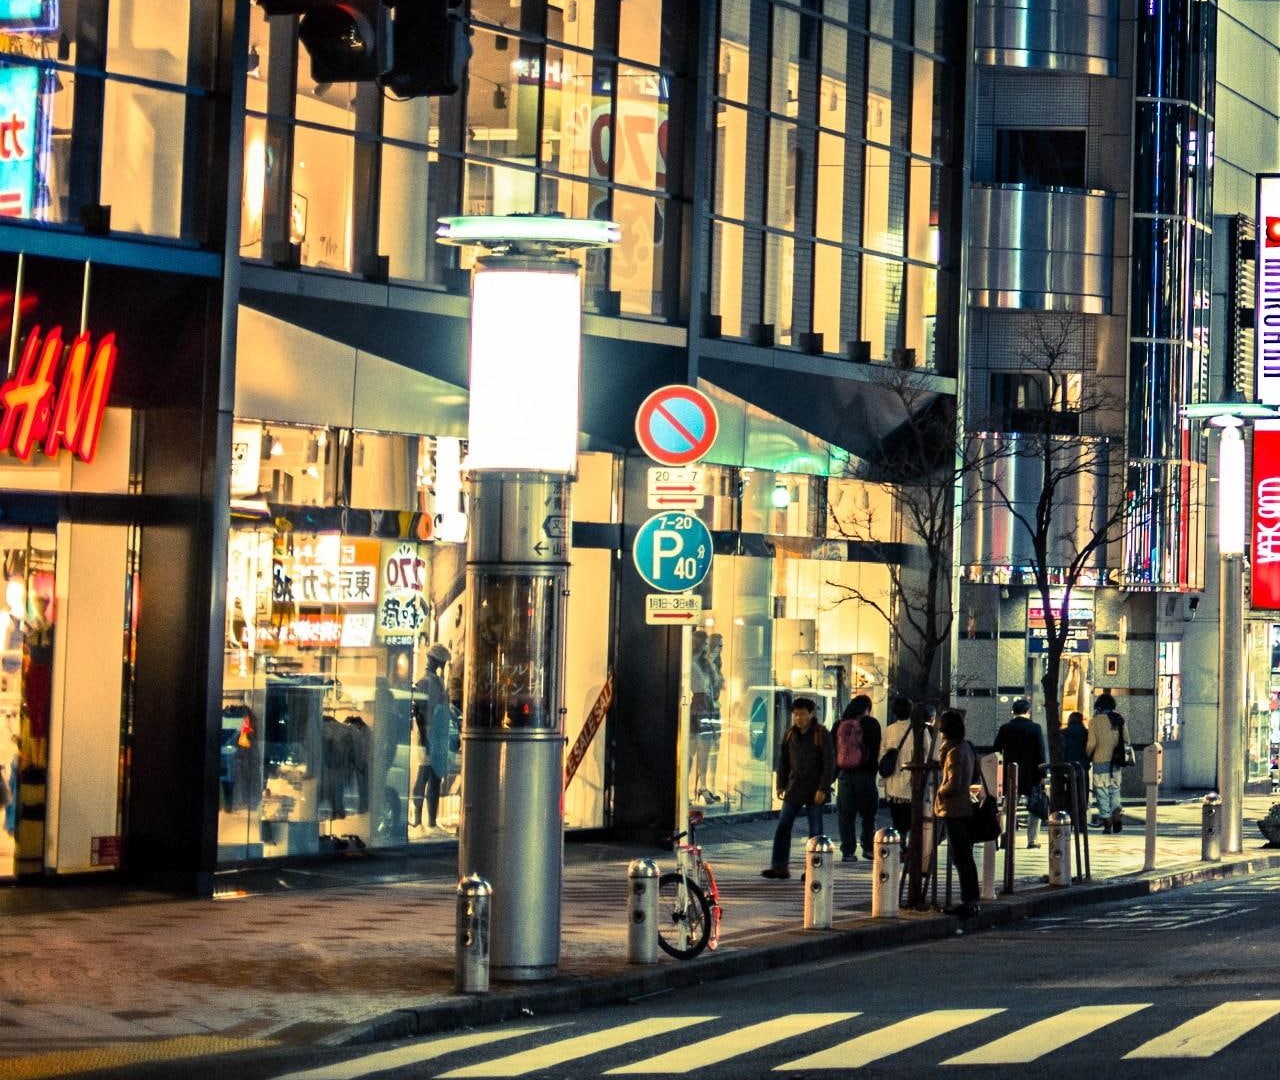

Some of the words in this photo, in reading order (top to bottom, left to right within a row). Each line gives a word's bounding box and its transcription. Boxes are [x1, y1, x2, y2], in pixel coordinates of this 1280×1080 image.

[656, 471, 670, 481] 20
[658, 517, 693, 530] 7-20
[652, 530, 684, 580] P
[674, 556, 697, 580] 40
